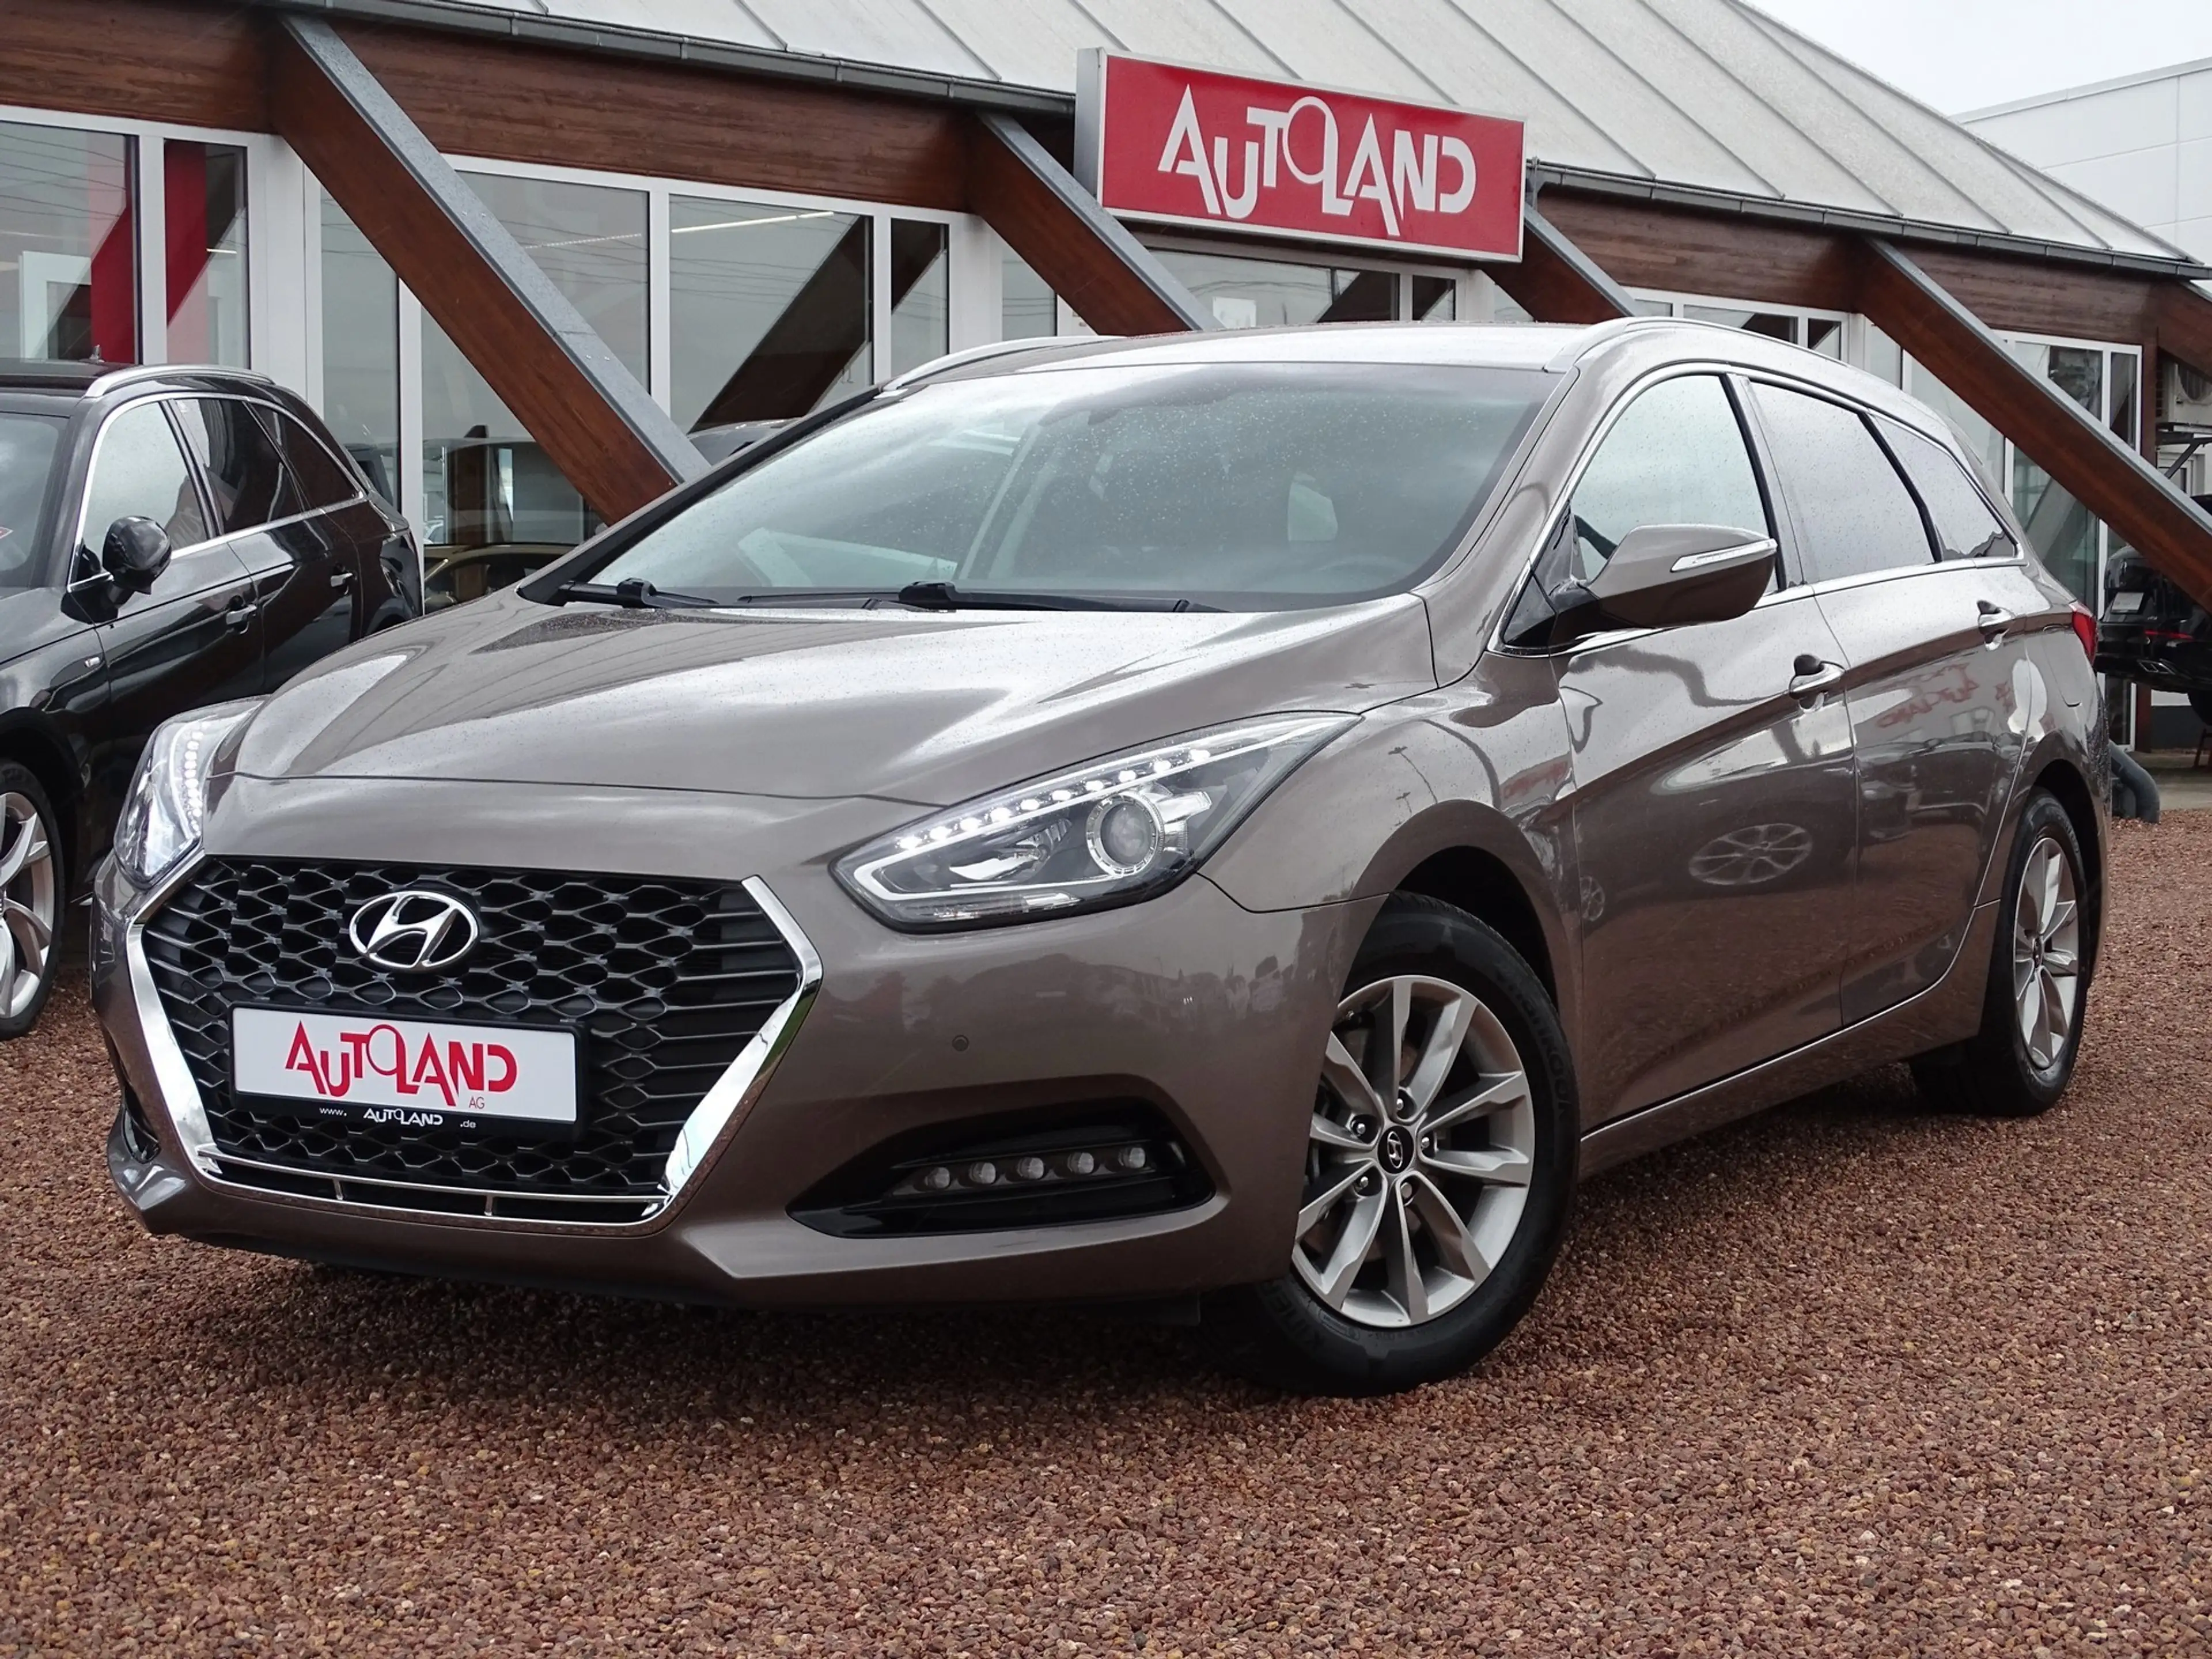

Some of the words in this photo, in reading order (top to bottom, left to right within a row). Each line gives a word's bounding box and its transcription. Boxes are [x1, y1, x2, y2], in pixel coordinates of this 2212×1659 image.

[1157, 84, 1476, 236] AUTOLAND
[285, 1020, 517, 1106] AUTOLAND
[319, 1108, 347, 1116] www.
[363, 1108, 443, 1127] AUTOLAND
[460, 1119, 476, 1128] .de
[468, 1096, 485, 1109] AG
